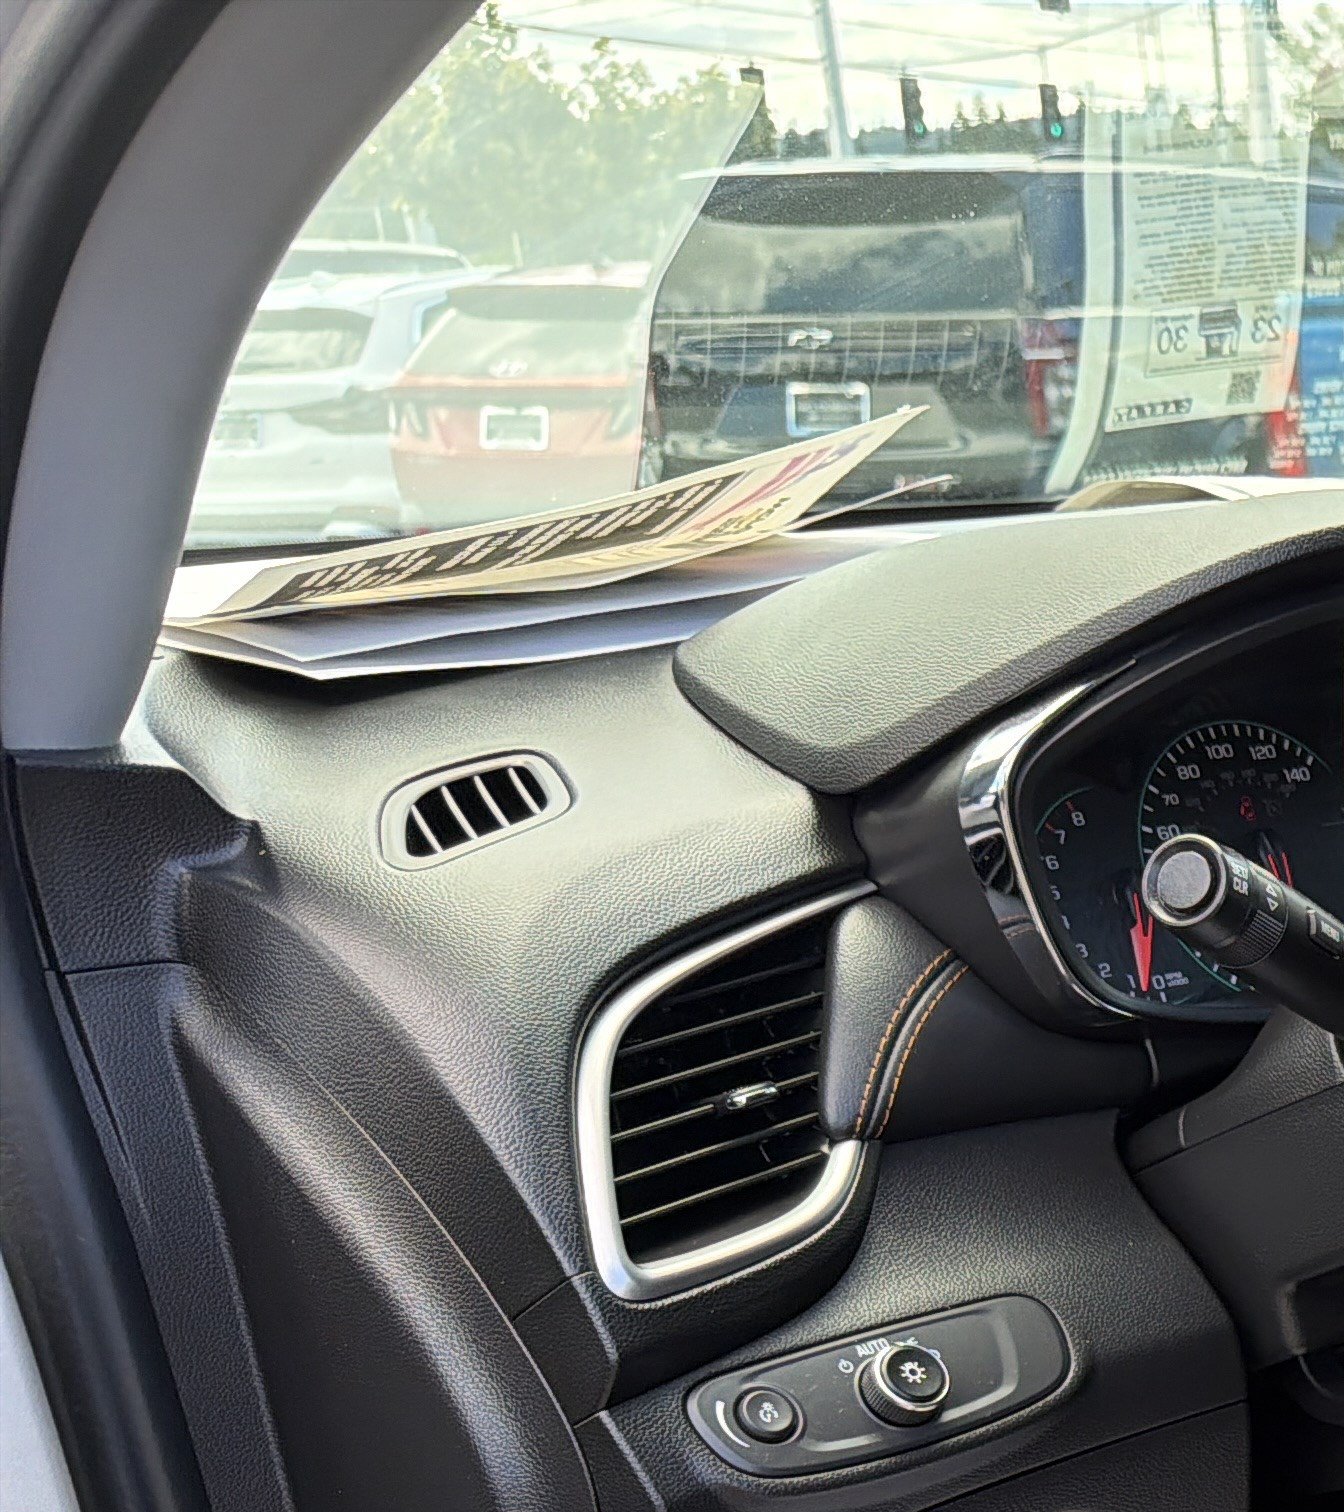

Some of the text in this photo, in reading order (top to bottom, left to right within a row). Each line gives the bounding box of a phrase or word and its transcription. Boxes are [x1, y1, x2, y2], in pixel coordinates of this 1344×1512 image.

[1204, 743, 1234, 760] 100
[1249, 744, 1277, 761] 120
[1176, 764, 1201, 781] 80
[1282, 766, 1311, 783] 140
[1161, 793, 1180, 806] 70
[1070, 810, 1086, 827] 8
[1054, 828, 1066, 845] 7
[1156, 823, 1181, 841] 60
[1045, 854, 1060, 871] 6
[1075, 942, 1089, 959] 3
[1098, 962, 1113, 979] 2
[1126, 974, 1137, 989] 1
[1151, 974, 1166, 990] 0
[854, 1337, 890, 1358] AUTO
